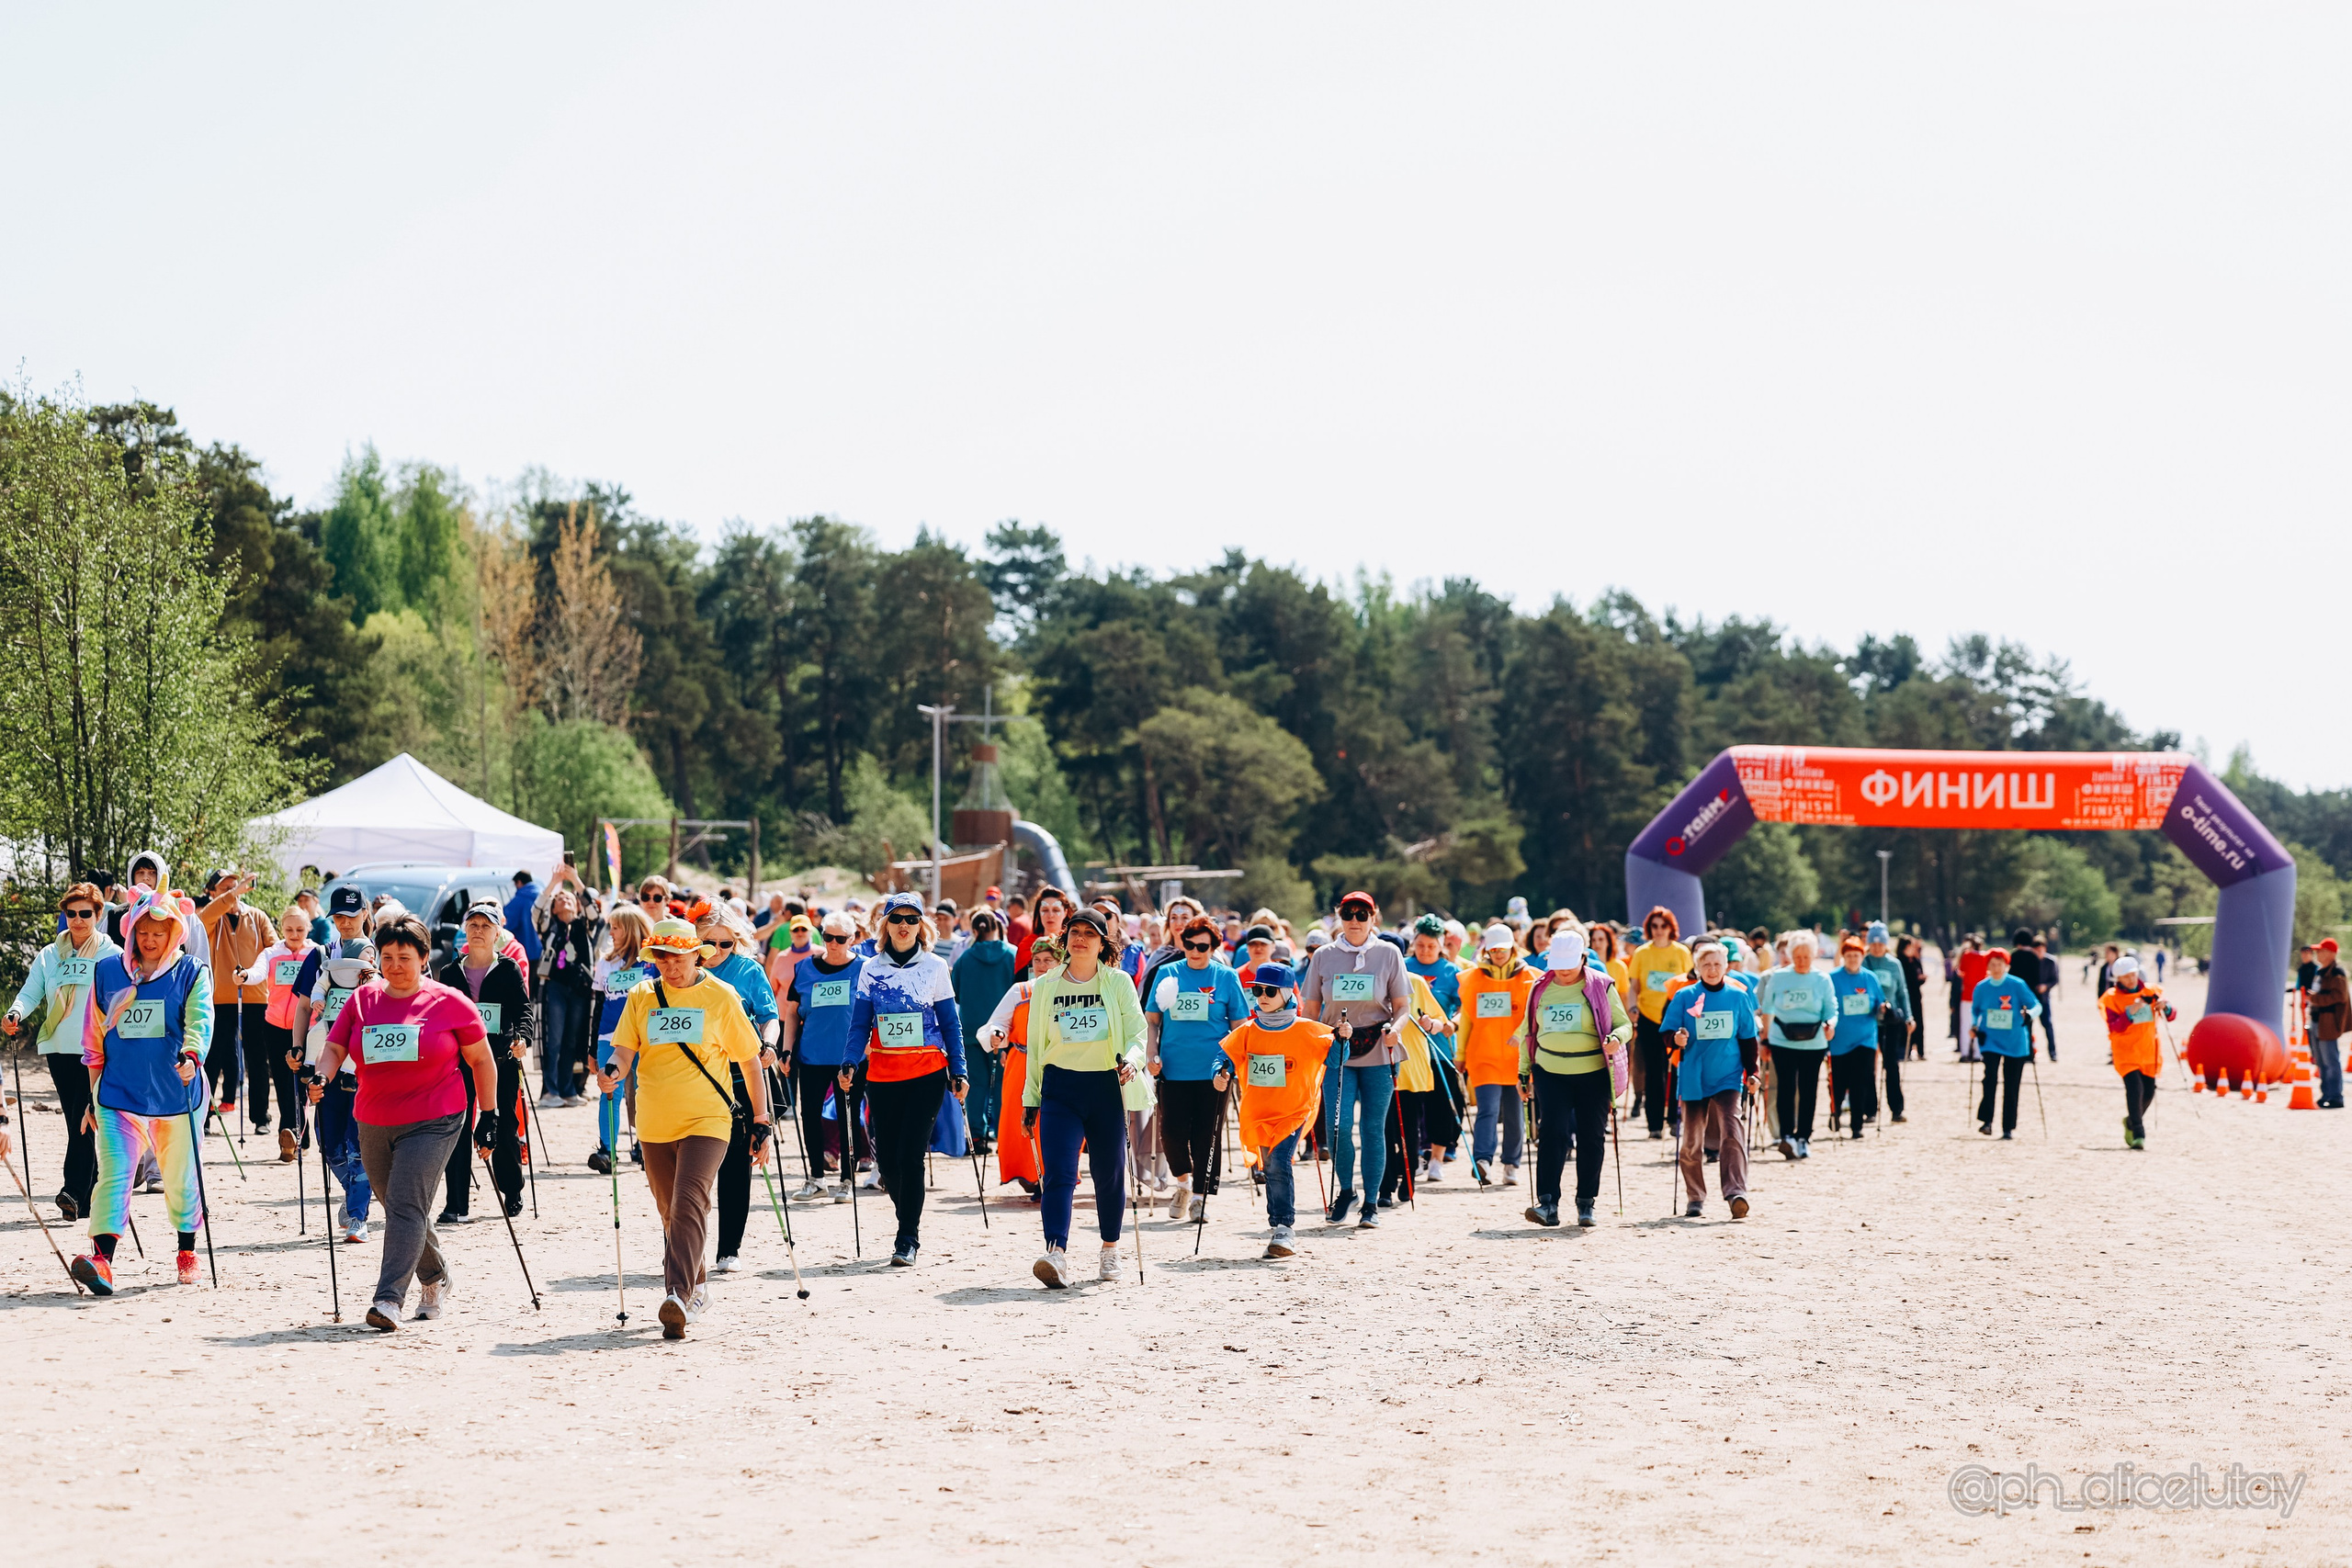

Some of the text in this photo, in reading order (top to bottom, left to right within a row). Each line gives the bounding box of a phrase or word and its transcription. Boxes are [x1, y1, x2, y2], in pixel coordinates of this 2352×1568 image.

[2137, 774, 2182, 787] FINIS
[1860, 769, 2055, 809] ФИНИШ
[2083, 804, 2134, 818] FINISH
[2180, 806, 2245, 871] o-time.ru
[62, 963, 87, 976] 212
[615, 973, 636, 983] 258
[820, 986, 842, 997] 208
[1341, 980, 1365, 991] 276
[331, 997, 346, 1010] 25
[1484, 998, 1504, 1009] 292
[1789, 992, 1807, 1002] 270
[1177, 998, 1200, 1010] 285
[123, 1008, 153, 1024] 207
[478, 1009, 492, 1021] 20
[1551, 1010, 1573, 1022] 256
[659, 1016, 692, 1031] 286
[887, 1021, 914, 1036] 254
[1069, 1014, 1097, 1030] 245
[1704, 1018, 1725, 1030] 291
[373, 1032, 407, 1049] 289
[1252, 1061, 1276, 1076] 246
